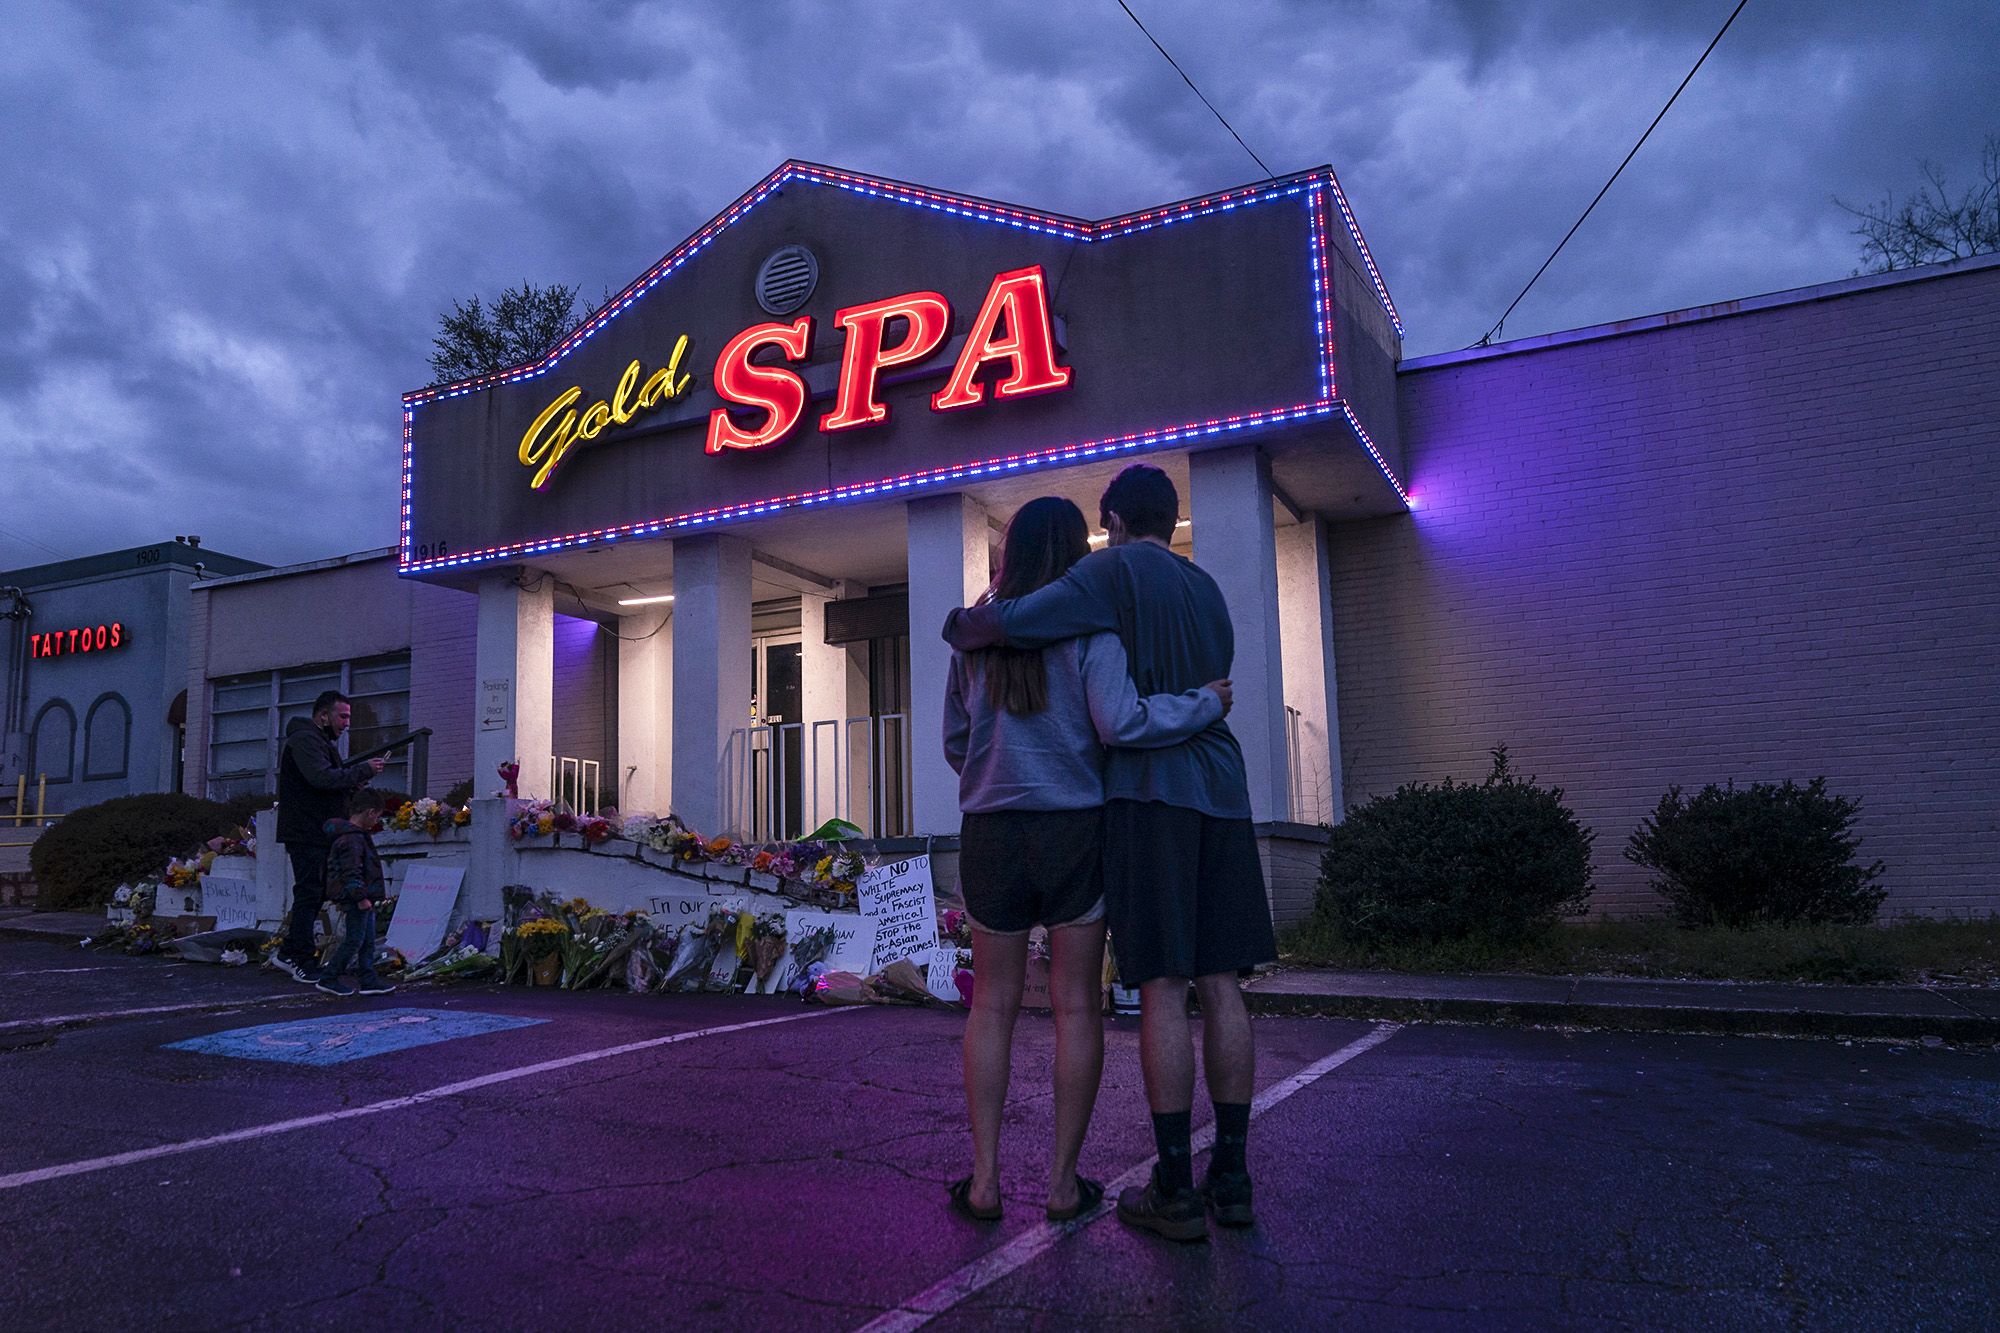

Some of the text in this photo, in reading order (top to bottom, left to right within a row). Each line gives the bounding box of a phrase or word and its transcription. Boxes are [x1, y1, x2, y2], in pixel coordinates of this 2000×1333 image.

[519, 264, 1074, 489] Gold SPA
[137, 549, 160, 564] 1900
[414, 541, 448, 560] 1916
[31, 622, 122, 659] TATTOOS
[862, 857, 929, 884] SAY NO TO
[860, 878, 896, 897] WHITE
[874, 883, 924, 905] SUPREMACY
[649, 898, 670, 915] In
[679, 900, 705, 914] our
[875, 922, 921, 942] STOP the
[873, 935, 919, 955] nti-Asian
[876, 951, 898, 966] hate
